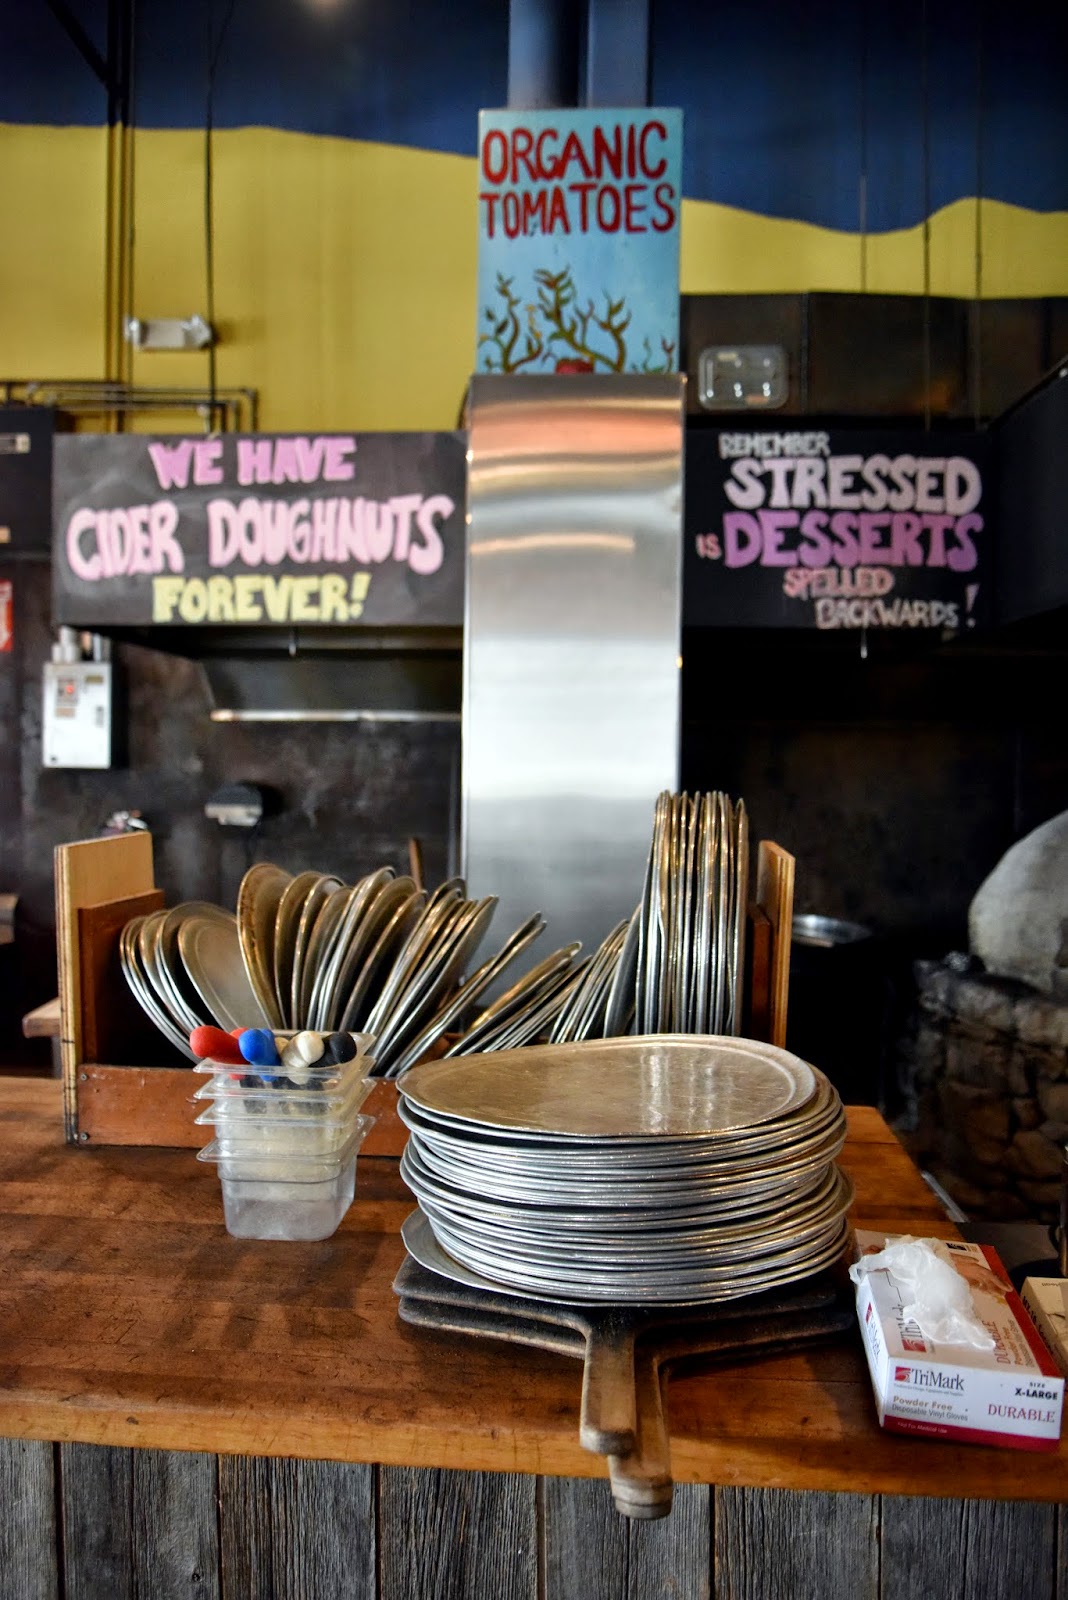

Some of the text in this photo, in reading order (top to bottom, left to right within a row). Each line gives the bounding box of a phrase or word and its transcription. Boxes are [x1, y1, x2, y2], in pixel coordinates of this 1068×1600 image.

[482, 120, 668, 185] ORGANIC
[479, 182, 676, 239] TOMATOES
[148, 436, 357, 490] WE HAVE
[719, 431, 830, 459] REMEMBER
[723, 454, 982, 516] STRESSED
[66, 494, 455, 581] CIDER DOUGHNUTS
[695, 509, 985, 572] IS DESSERTS
[152, 572, 372, 623] FOREVER!
[783, 567, 896, 601] SPELLED
[911, 1368, 965, 1391] TriMark
[1014, 1388, 1058, 1401] X-LARGE
[891, 1403, 969, 1422] Disposable Vinyl Gloves
[893, 1395, 954, 1411] Powder Free
[987, 1403, 1056, 1424] DURABLE
